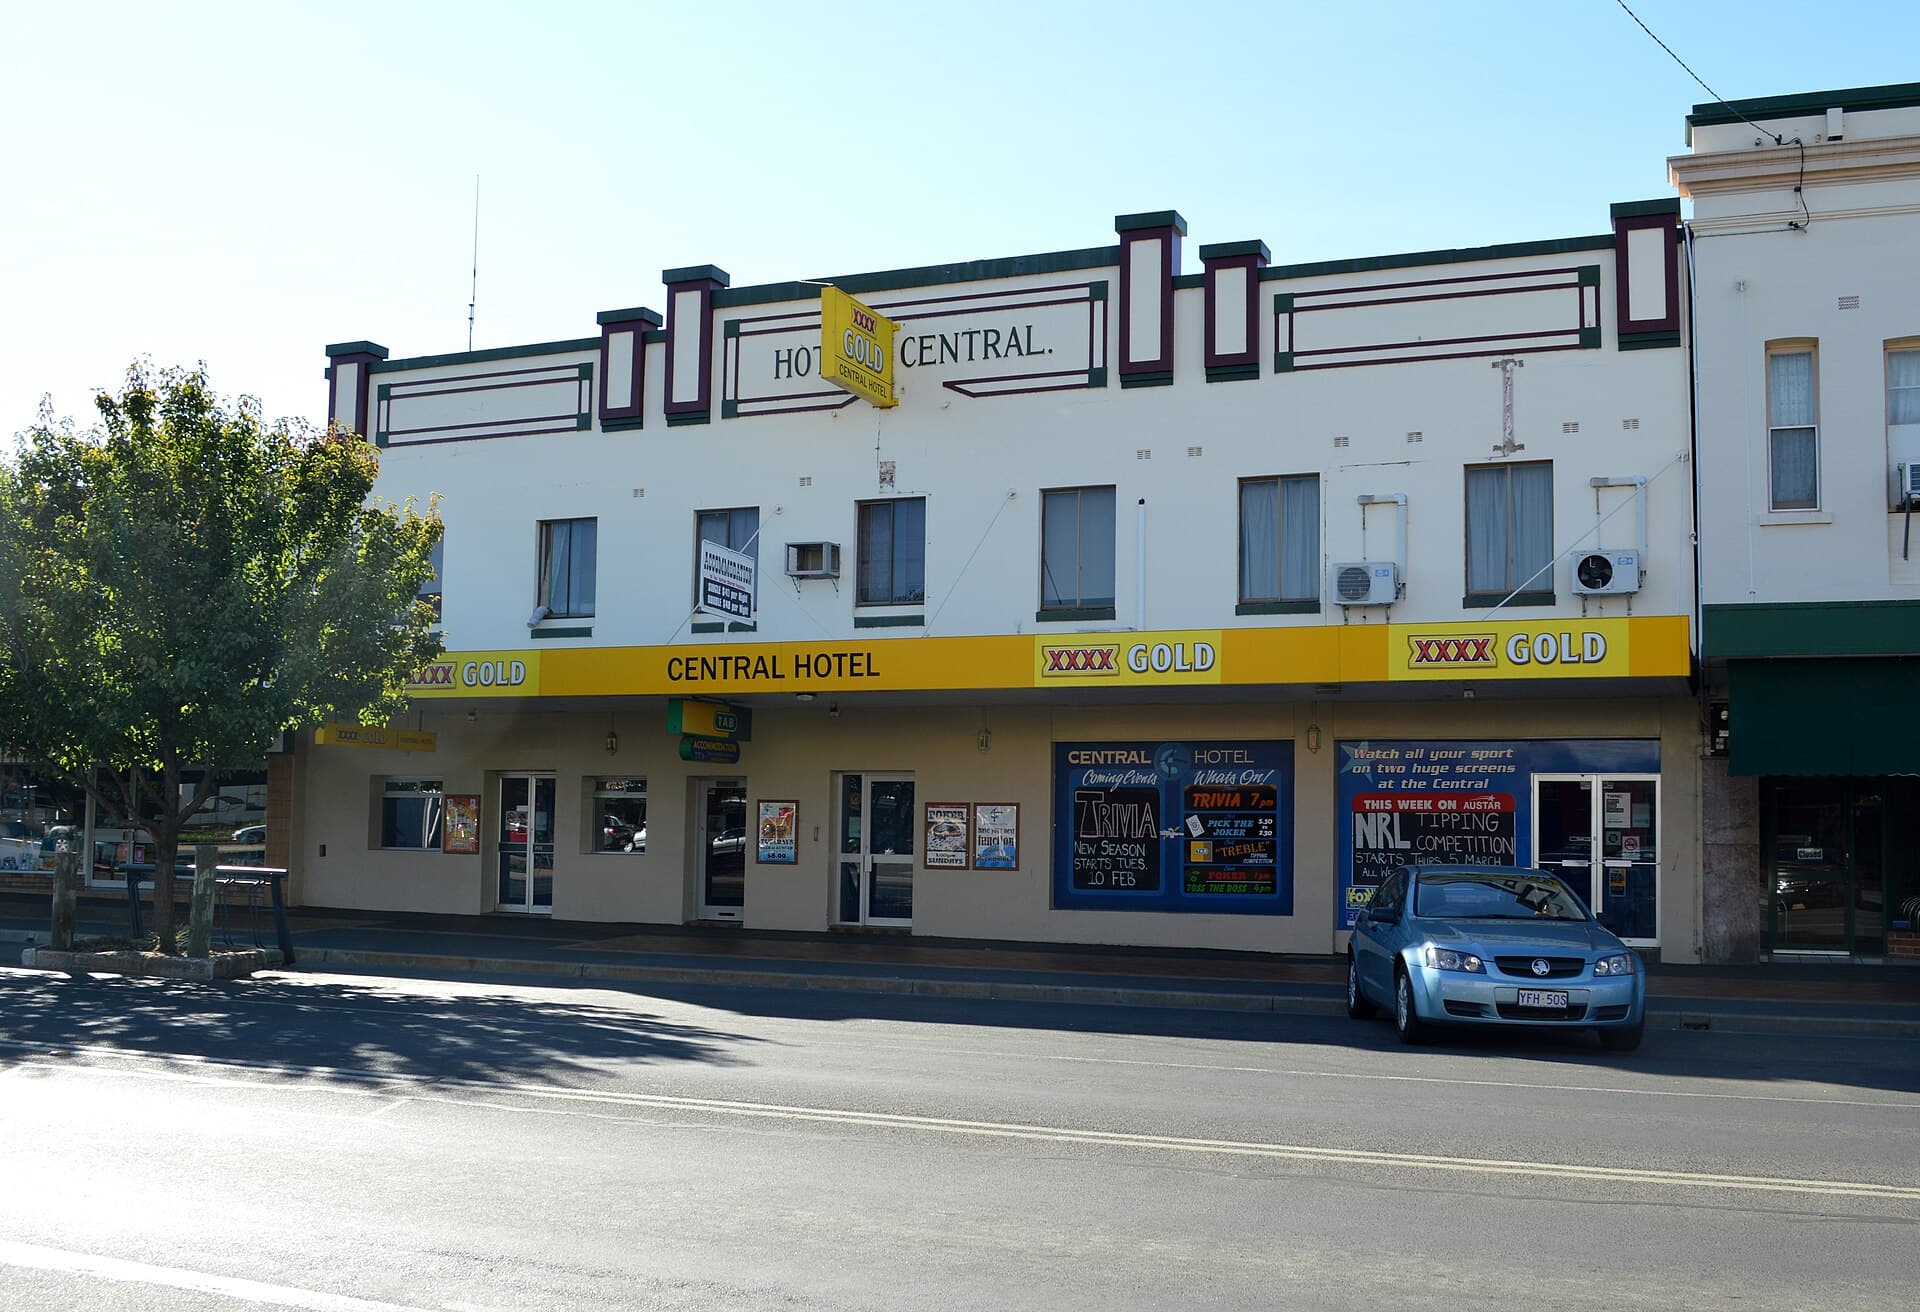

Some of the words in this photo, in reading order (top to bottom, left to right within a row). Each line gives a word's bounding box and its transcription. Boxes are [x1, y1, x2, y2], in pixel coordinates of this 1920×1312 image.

[852, 308, 876, 334] XXXX
[842, 328, 884, 373] GOLD
[774, 345, 822, 380] HOT
[839, 363, 868, 389] CENTRAL
[868, 379, 888, 399] HOTEL
[1414, 639, 1491, 662] XXXX
[1505, 632, 1607, 666] GOLD
[1048, 649, 1114, 671] XXXX
[1127, 643, 1215, 674] GOLD
[462, 660, 526, 686] GOLD
[667, 655, 785, 681] CENTRAL
[794, 652, 880, 678] HOTEL
[717, 715, 735, 729] TAB
[1068, 750, 1152, 764] CENTRAL
[1194, 750, 1255, 764] HOTEL
[1353, 749, 1399, 760] Watch
[1405, 749, 1424, 759] all
[1429, 751, 1465, 761] your
[1471, 749, 1513, 760] sport
[1193, 769, 1237, 785] Whats
[1239, 769, 1275, 785] On!
[1352, 765, 1370, 774] on
[1377, 765, 1405, 773] two
[1412, 764, 1449, 776] huge
[1455, 764, 1516, 773] screens
[1082, 769, 1124, 792] Coming
[1378, 780, 1394, 789] at
[1401, 780, 1426, 789] the
[1433, 779, 1489, 789] Central
[1193, 793, 1241, 808] TRIVIA
[1250, 792, 1260, 806] 7
[1259, 798, 1275, 808] pm
[1363, 800, 1392, 809] THIS
[1398, 800, 1432, 809] WEEK
[1438, 800, 1457, 809] ON
[1463, 801, 1501, 810] AUSTAR
[928, 810, 965, 820] POKER
[1075, 790, 1158, 839] TRIVIA
[1415, 812, 1499, 832] TIPPING
[1207, 820, 1230, 828] PICK
[1234, 820, 1254, 828] THE
[1354, 812, 1411, 849] NRL
[978, 834, 1014, 846] function
[1212, 829, 1246, 837] JOKER
[1074, 841, 1097, 855] NEW
[1100, 840, 1146, 856] SEASON
[1416, 835, 1515, 855] COMPETITION
[927, 857, 964, 865] SUNDAYS
[1074, 858, 1112, 870] STARTS
[1115, 858, 1149, 870] TUES.
[1355, 852, 1405, 866] STARTS
[1410, 852, 1443, 865] THURS
[1450, 853, 1459, 865] 5
[1464, 853, 1502, 866] MARCH
[1088, 870, 1105, 885] 10
[1111, 871, 1136, 886] FEB
[1207, 872, 1247, 880] POKER
[1361, 868, 1378, 878] ALL
[1185, 884, 1206, 893] TOSS
[1208, 884, 1225, 893] THE
[1226, 884, 1248, 893] BOSS
[1520, 992, 1540, 1004] YFH
